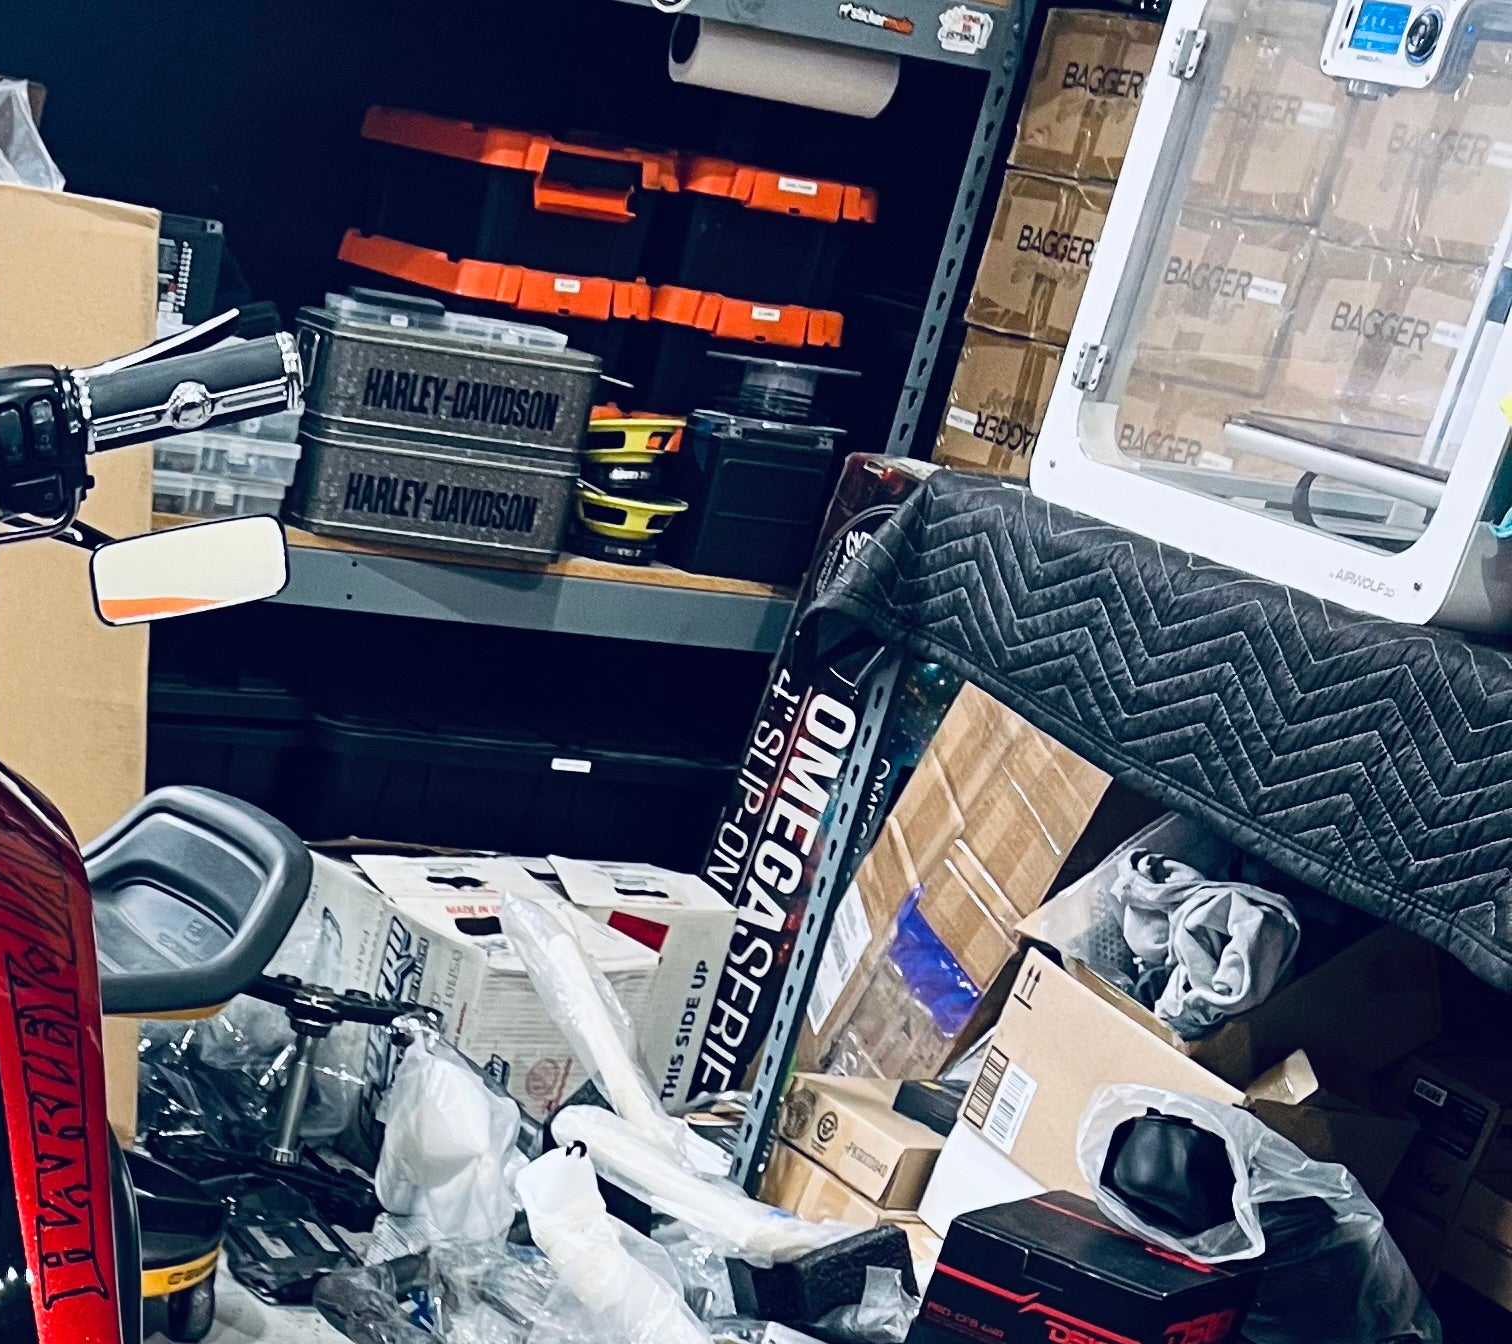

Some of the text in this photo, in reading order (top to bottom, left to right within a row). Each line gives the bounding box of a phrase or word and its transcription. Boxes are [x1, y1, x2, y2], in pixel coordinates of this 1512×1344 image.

[1062, 62, 1144, 99] BAGGER
[1016, 225, 1095, 268] BAGGER
[1165, 256, 1253, 300] BAGGER
[1331, 301, 1431, 350] BAGGER
[362, 367, 560, 432] HARLEY-DAVIDSON
[973, 411, 1037, 455] AGGER
[1119, 423, 1202, 466] BAGGER
[343, 472, 539, 533] HARLEY-DAVIDSON
[706, 720, 785, 891] SLIP-ON
[660, 960, 709, 1102] THIS SIDE UP
